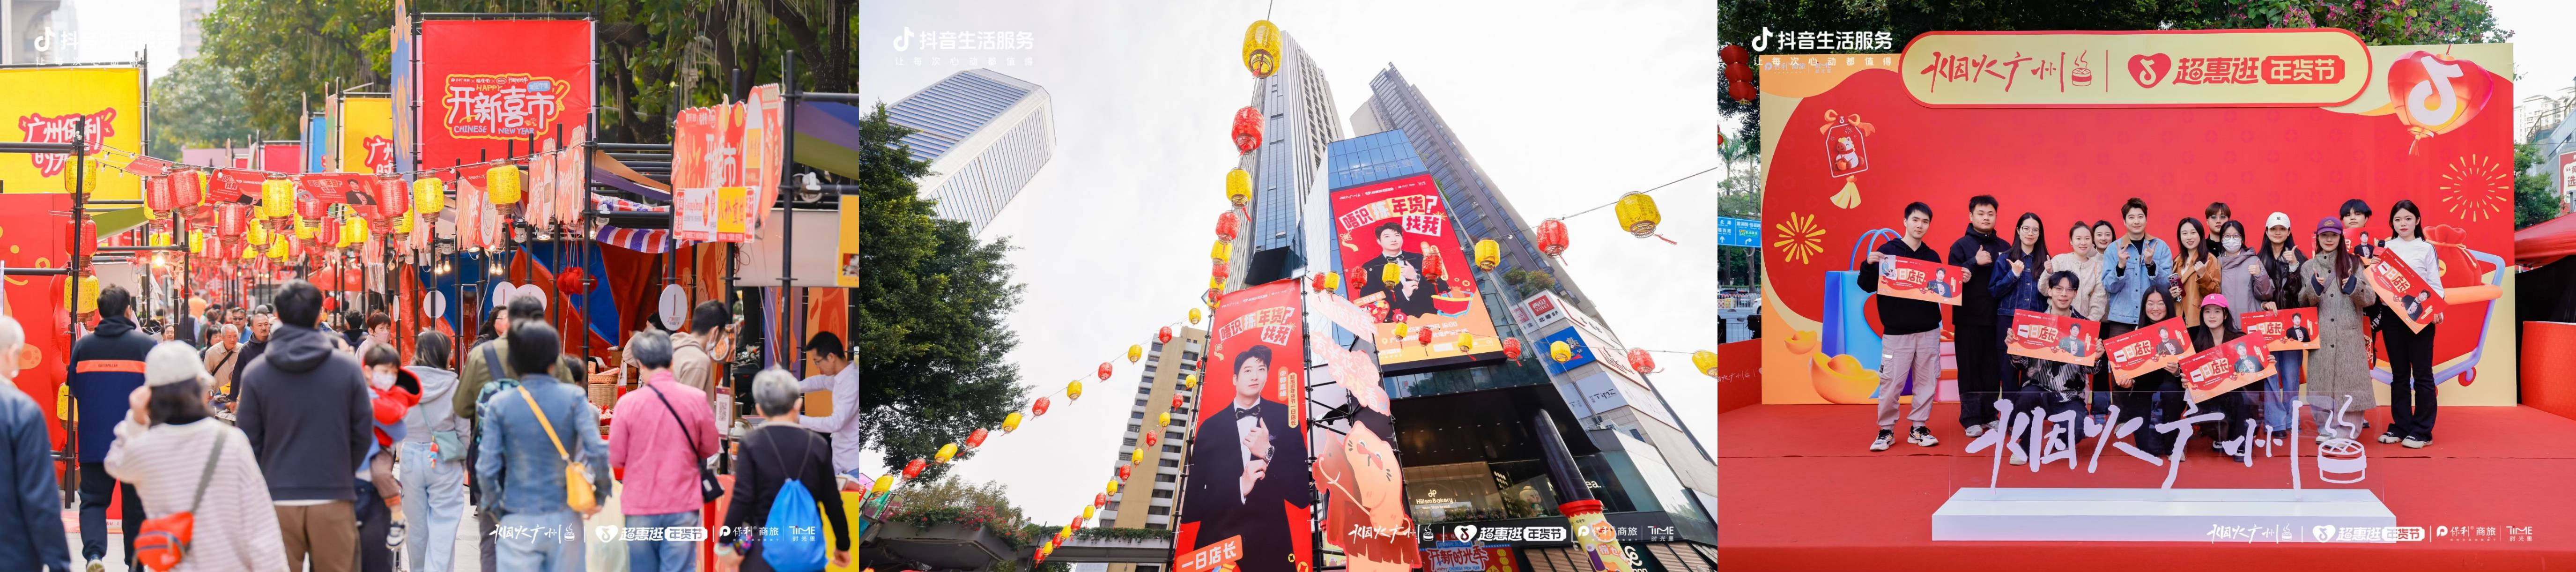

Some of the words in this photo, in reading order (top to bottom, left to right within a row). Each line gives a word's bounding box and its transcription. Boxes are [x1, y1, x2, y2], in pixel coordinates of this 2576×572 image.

[1921, 51, 2065, 93] 烟火广州
[2172, 57, 2260, 85] 超惠逛
[2271, 59, 2335, 81] 年货节
[447, 86, 555, 134] 开新喜市
[1406, 215, 1439, 235] 找我
[2382, 264, 2409, 292] 一日店长
[1536, 304, 1549, 312] XIBEI
[1263, 325, 1290, 344] 找我
[2020, 325, 2056, 341] 一日店长
[2116, 340, 2152, 360] 一日店长
[2192, 358, 2229, 379] 一日店长
[1965, 399, 2302, 502] 烟火广州
[1182, 541, 1236, 570] 一日店长
[1430, 545, 1488, 571] 开新时光季
